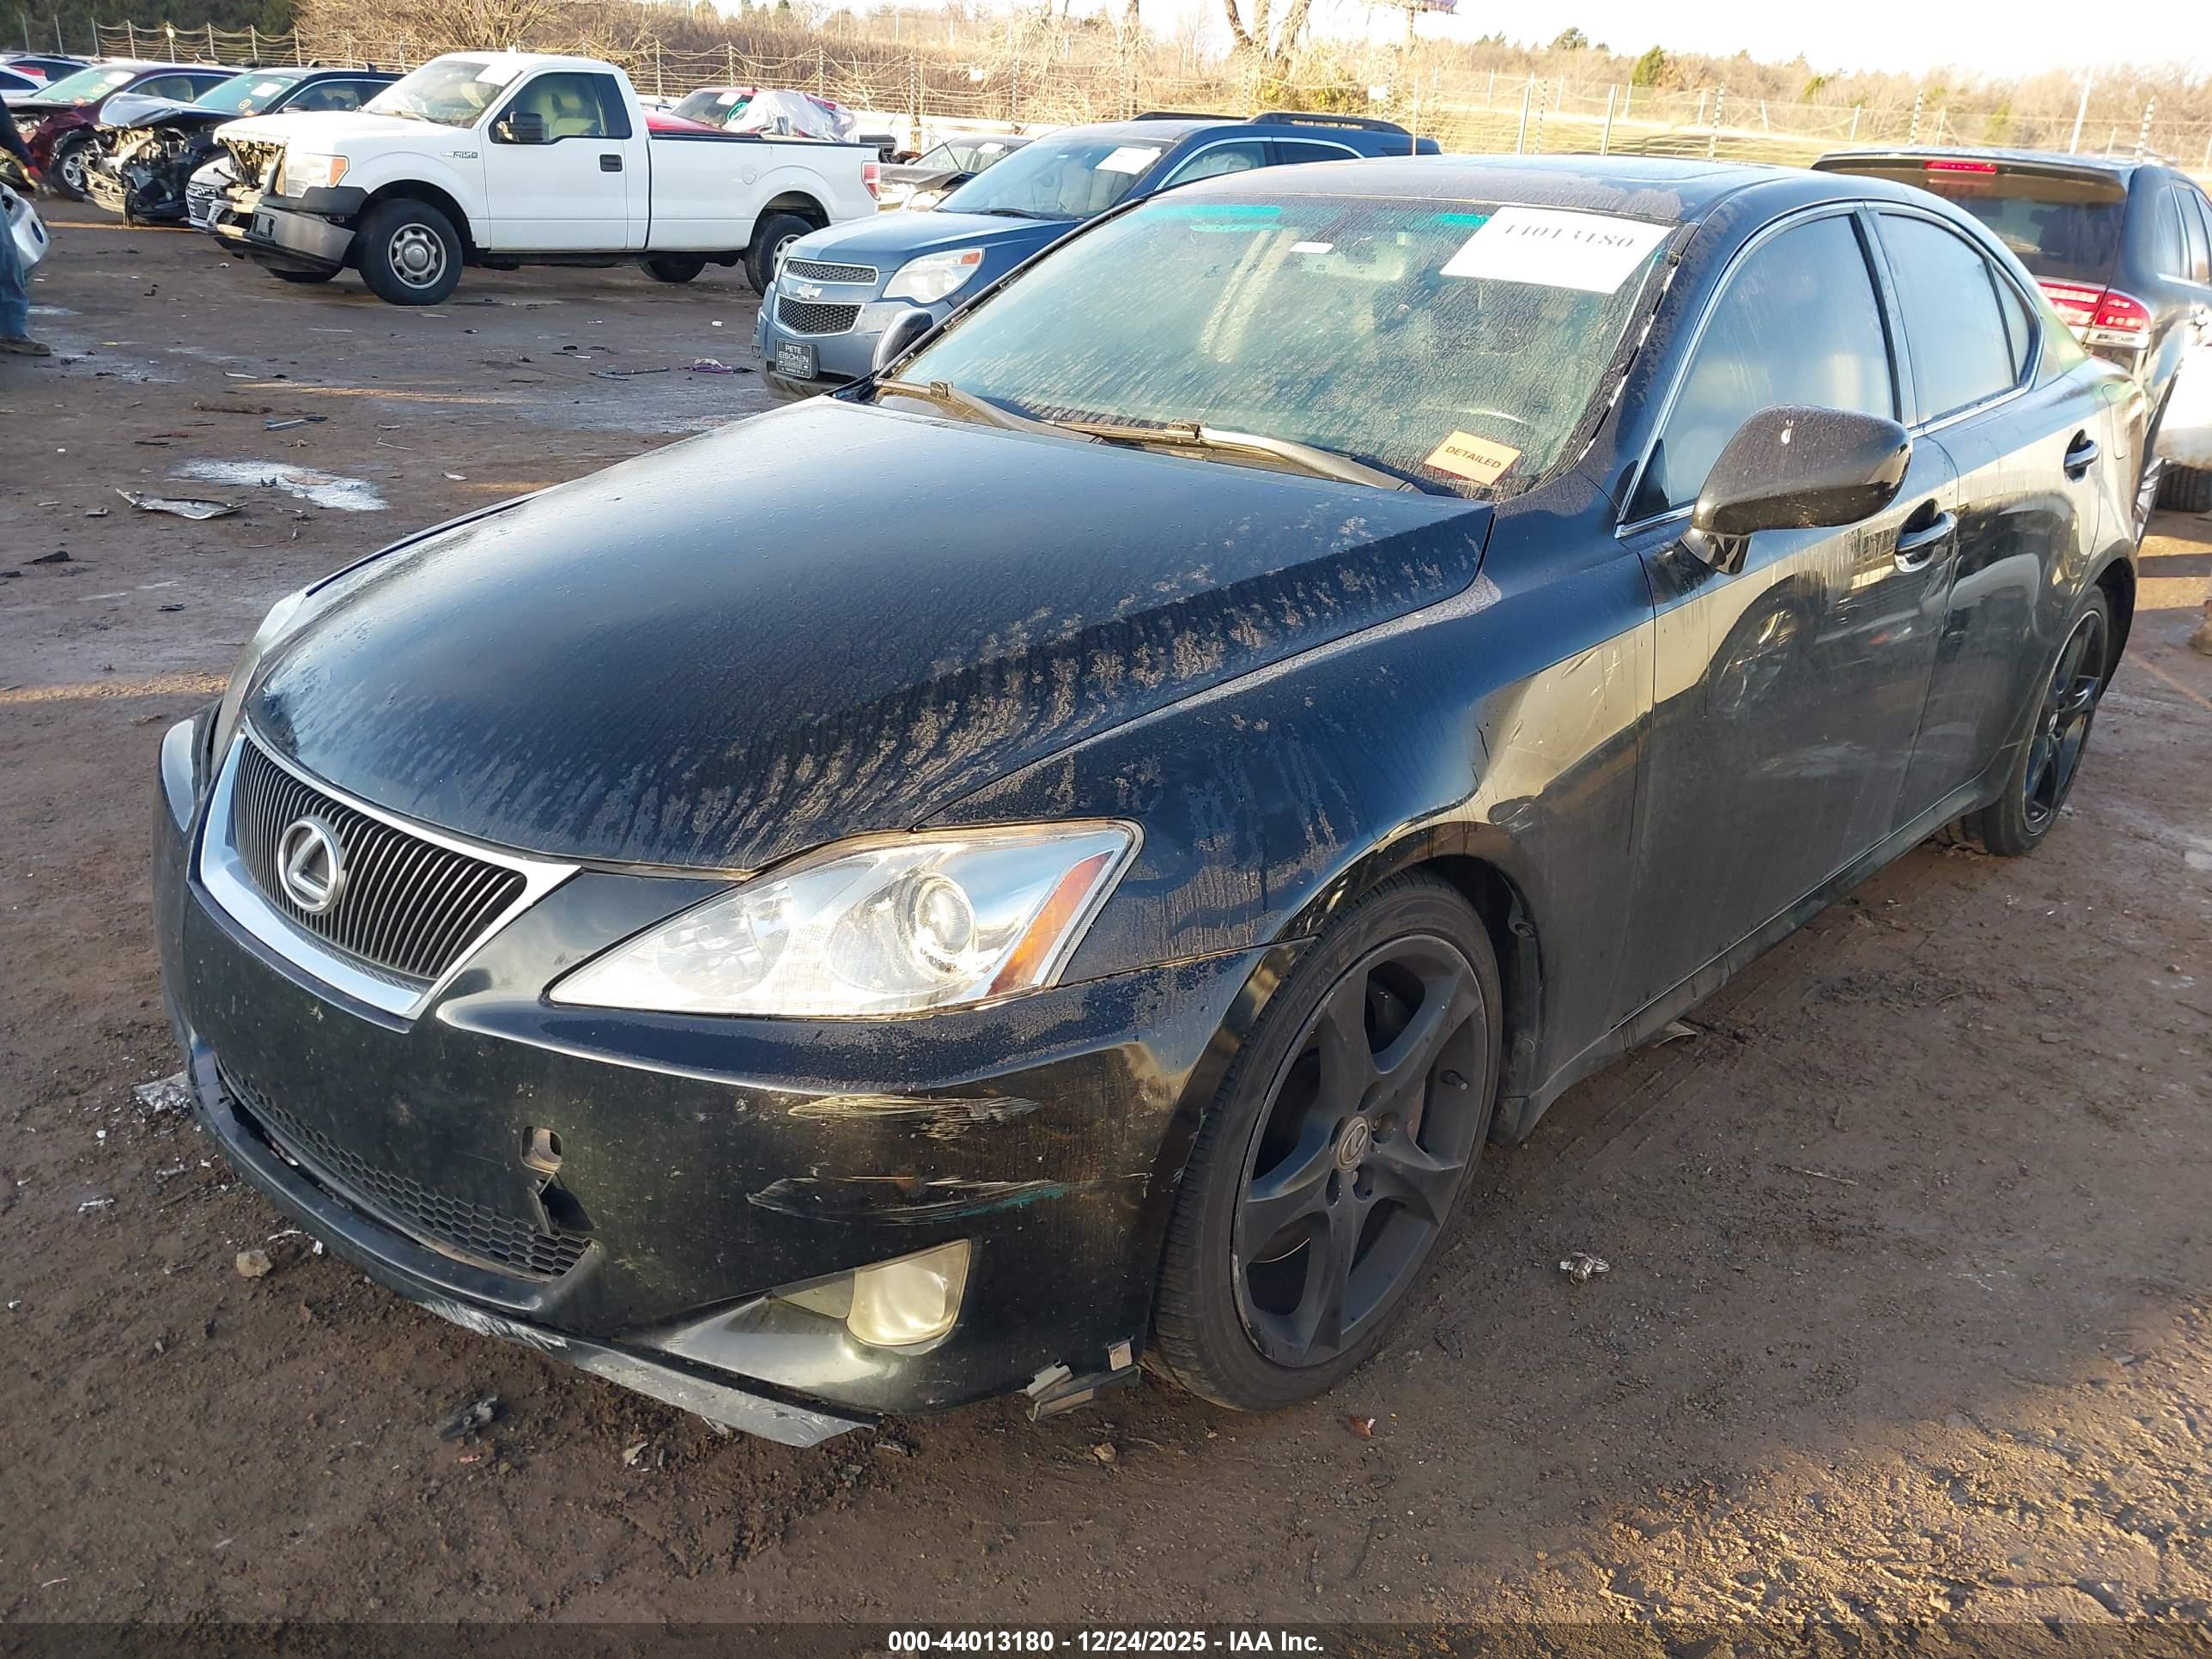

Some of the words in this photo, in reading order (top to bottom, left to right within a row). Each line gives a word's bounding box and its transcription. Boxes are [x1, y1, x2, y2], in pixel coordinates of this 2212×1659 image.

[785, 343, 803, 355] PETE
[778, 350, 810, 363] EISCHEN
[1445, 446, 1501, 468] DETAILED
